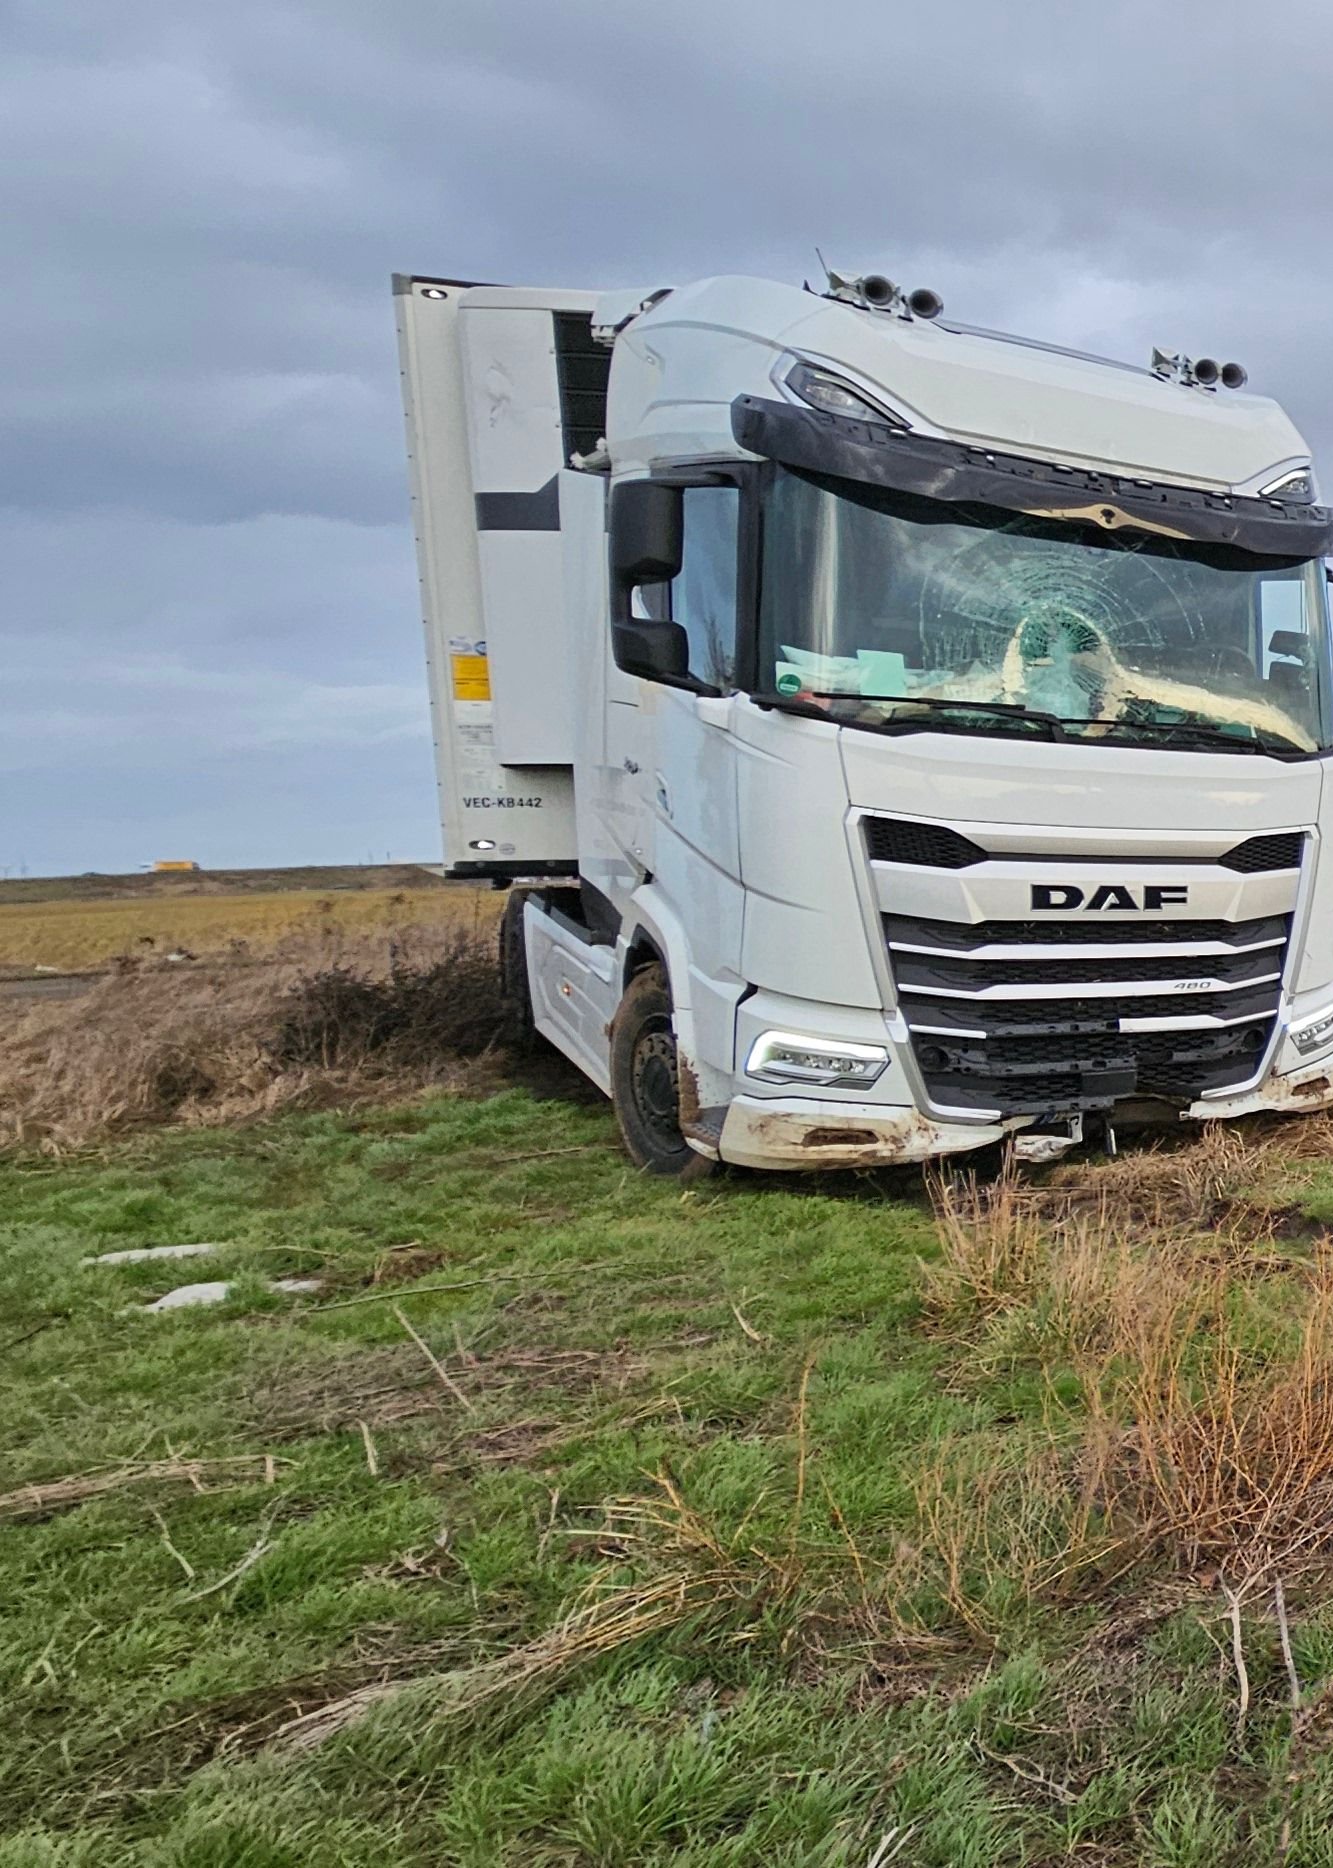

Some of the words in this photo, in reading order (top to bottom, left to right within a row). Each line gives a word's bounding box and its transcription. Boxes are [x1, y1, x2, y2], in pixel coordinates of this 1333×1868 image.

[463, 797, 543, 809] VEC-KB442
[1030, 884, 1189, 912] DAF
[1174, 981, 1211, 989] 480
